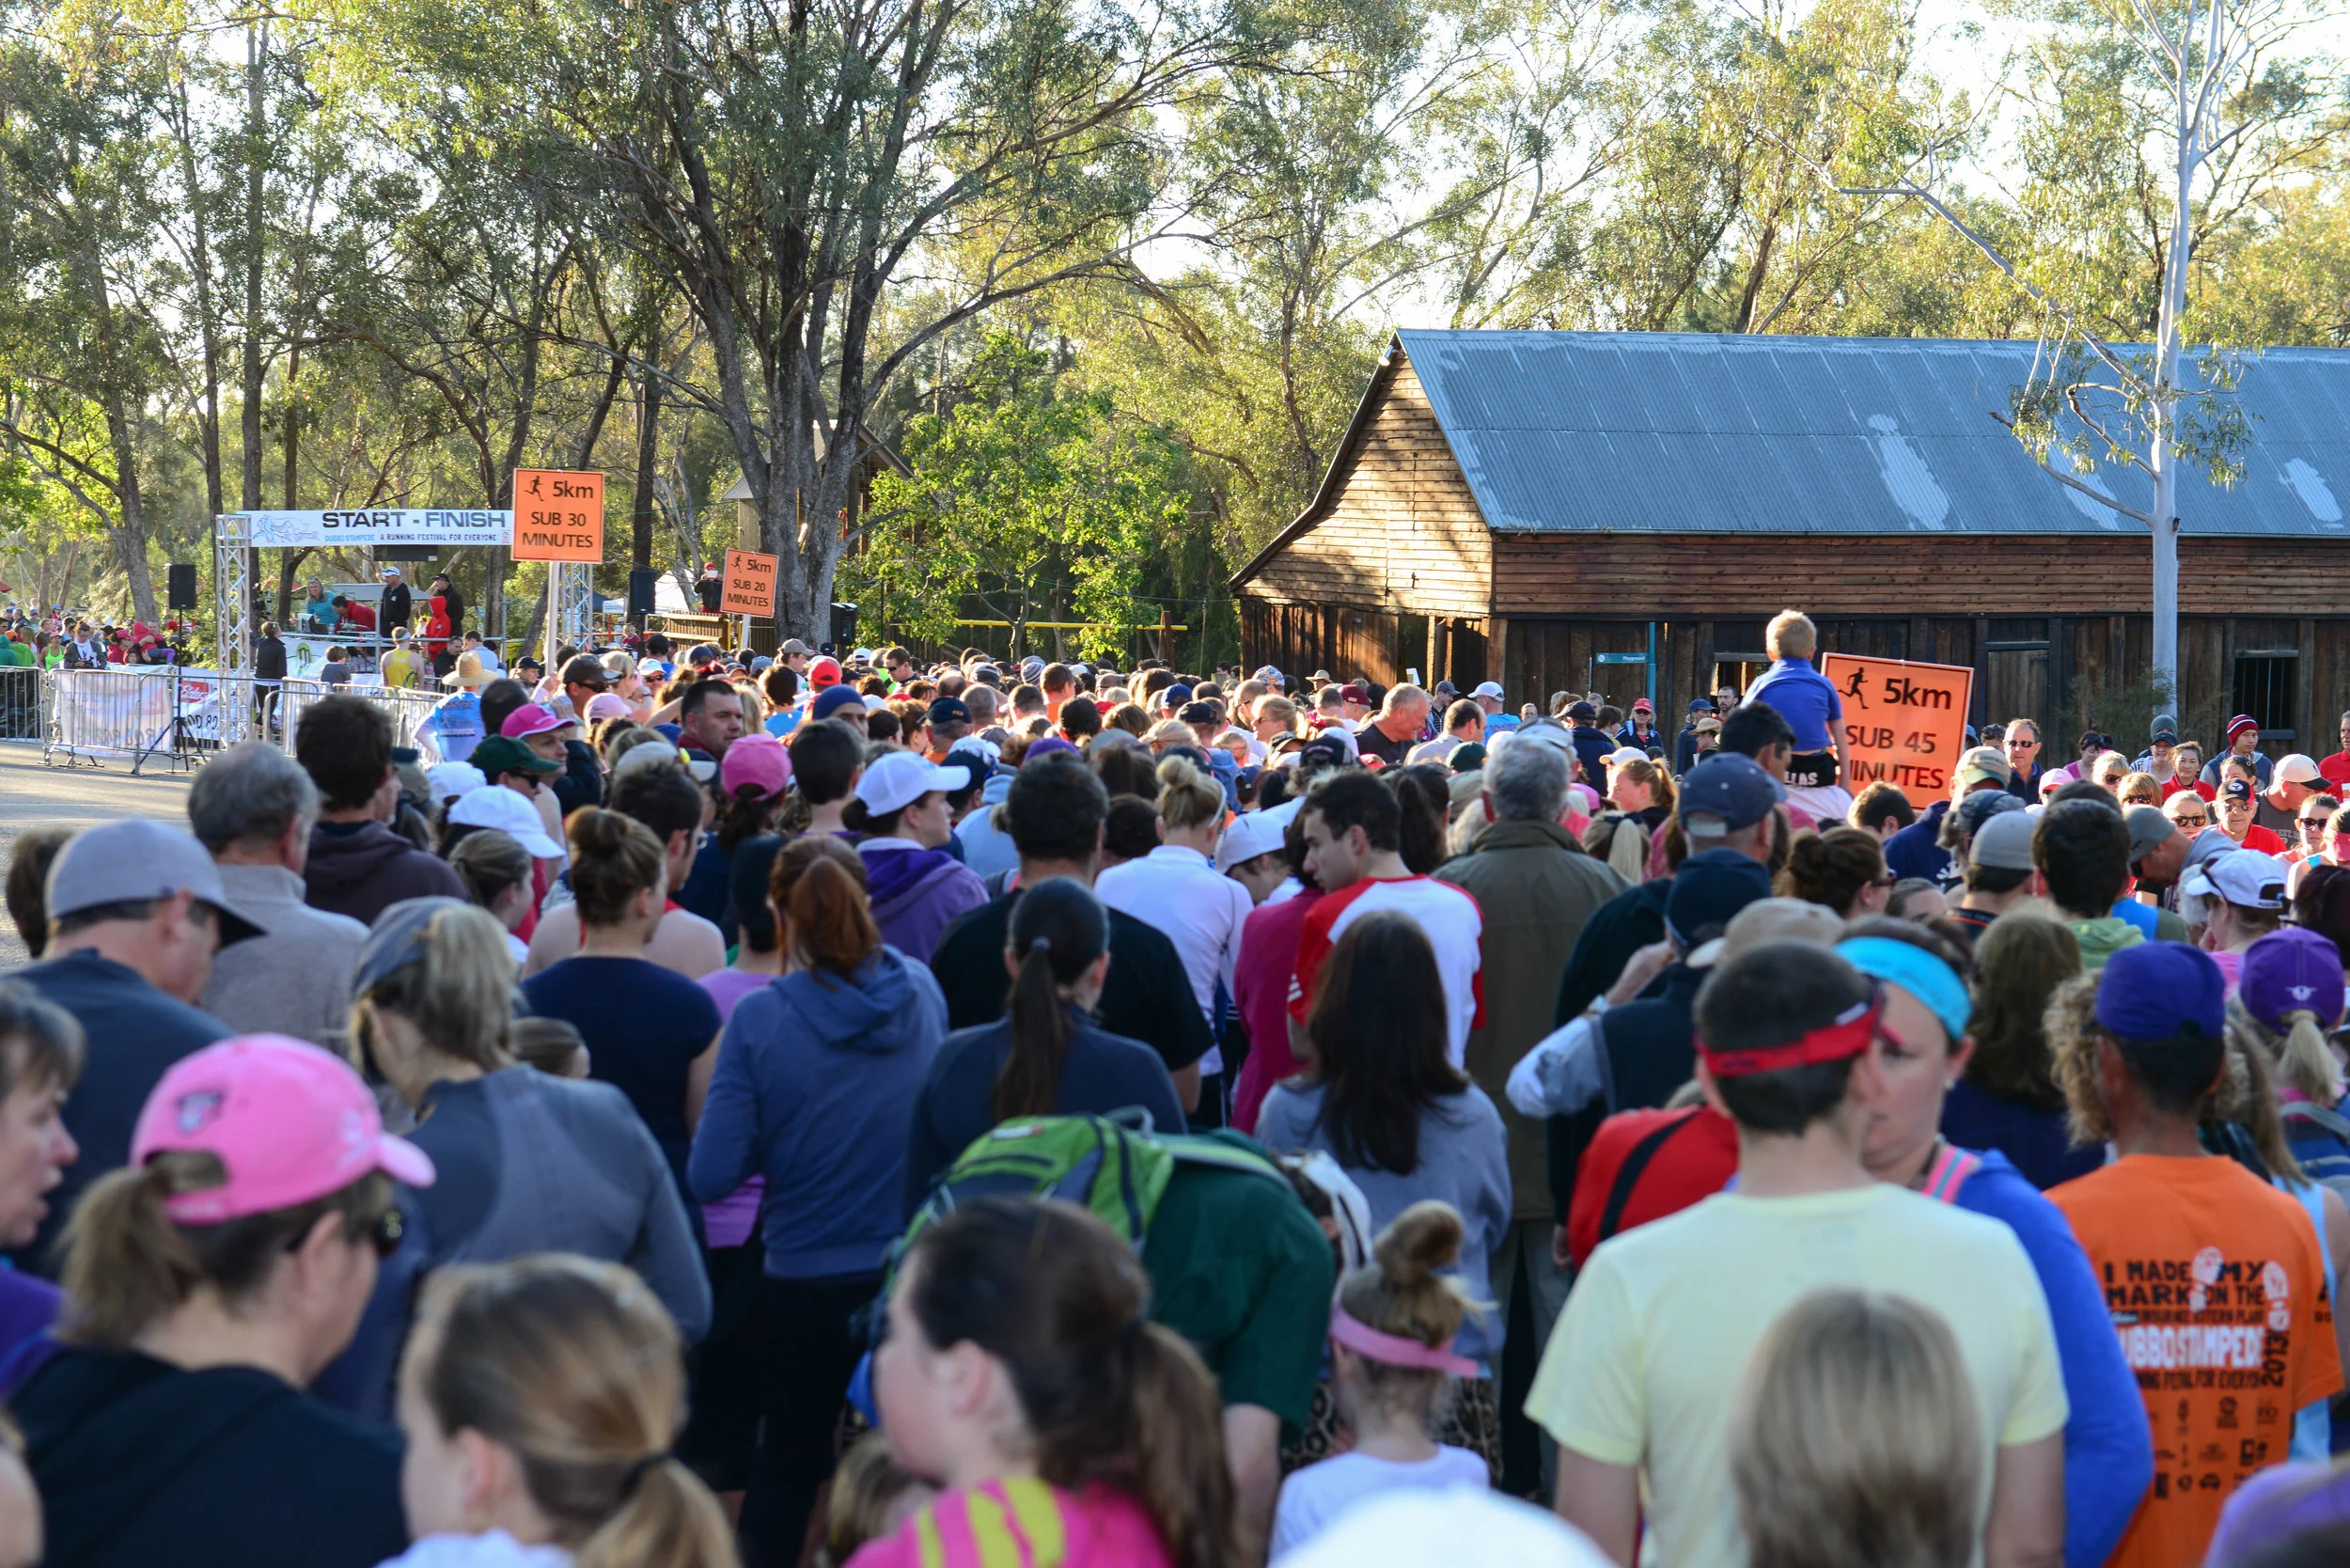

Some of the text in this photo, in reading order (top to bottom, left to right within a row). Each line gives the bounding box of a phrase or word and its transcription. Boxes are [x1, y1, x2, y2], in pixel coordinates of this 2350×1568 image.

[553, 480, 593, 498] 5km
[322, 511, 406, 527] START
[425, 511, 505, 527] FINISH
[531, 511, 587, 526] SUB 30
[523, 532, 593, 548] MINUTES
[747, 559, 772, 572] 5km
[733, 579, 766, 591] SUB 20
[728, 593, 769, 606] MINUTES
[1883, 678, 1951, 710] 5km
[1845, 725, 1937, 754] SUB 45
[2104, 1260, 2265, 1282] I MADE MY
[2107, 1284, 2264, 1306] MARK ON THE
